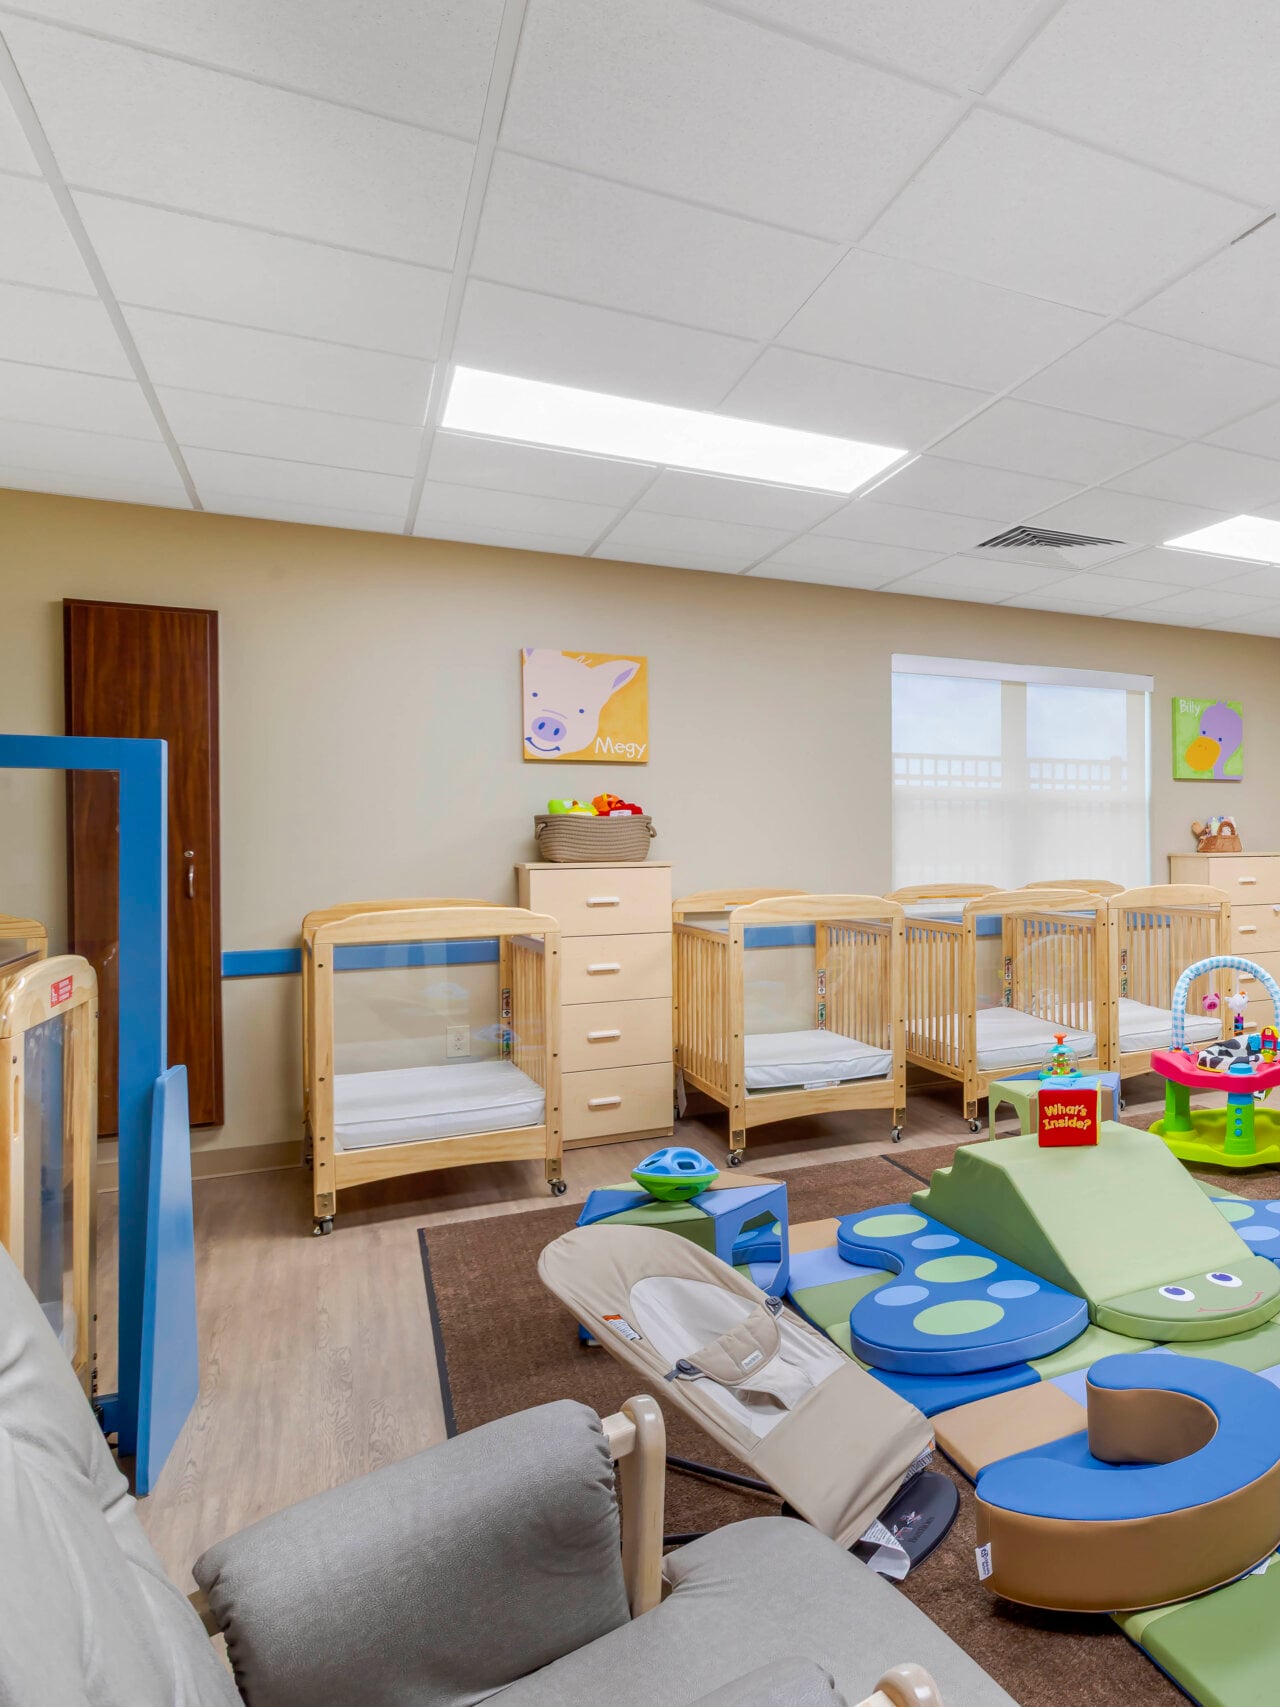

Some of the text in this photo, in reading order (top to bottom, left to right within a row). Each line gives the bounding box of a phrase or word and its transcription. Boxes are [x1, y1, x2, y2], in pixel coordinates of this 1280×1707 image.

[1180, 699, 1200, 717] Billy
[595, 736, 646, 759] Megy
[1044, 1103, 1087, 1117] What's
[1043, 1116, 1091, 1130] Inside?
